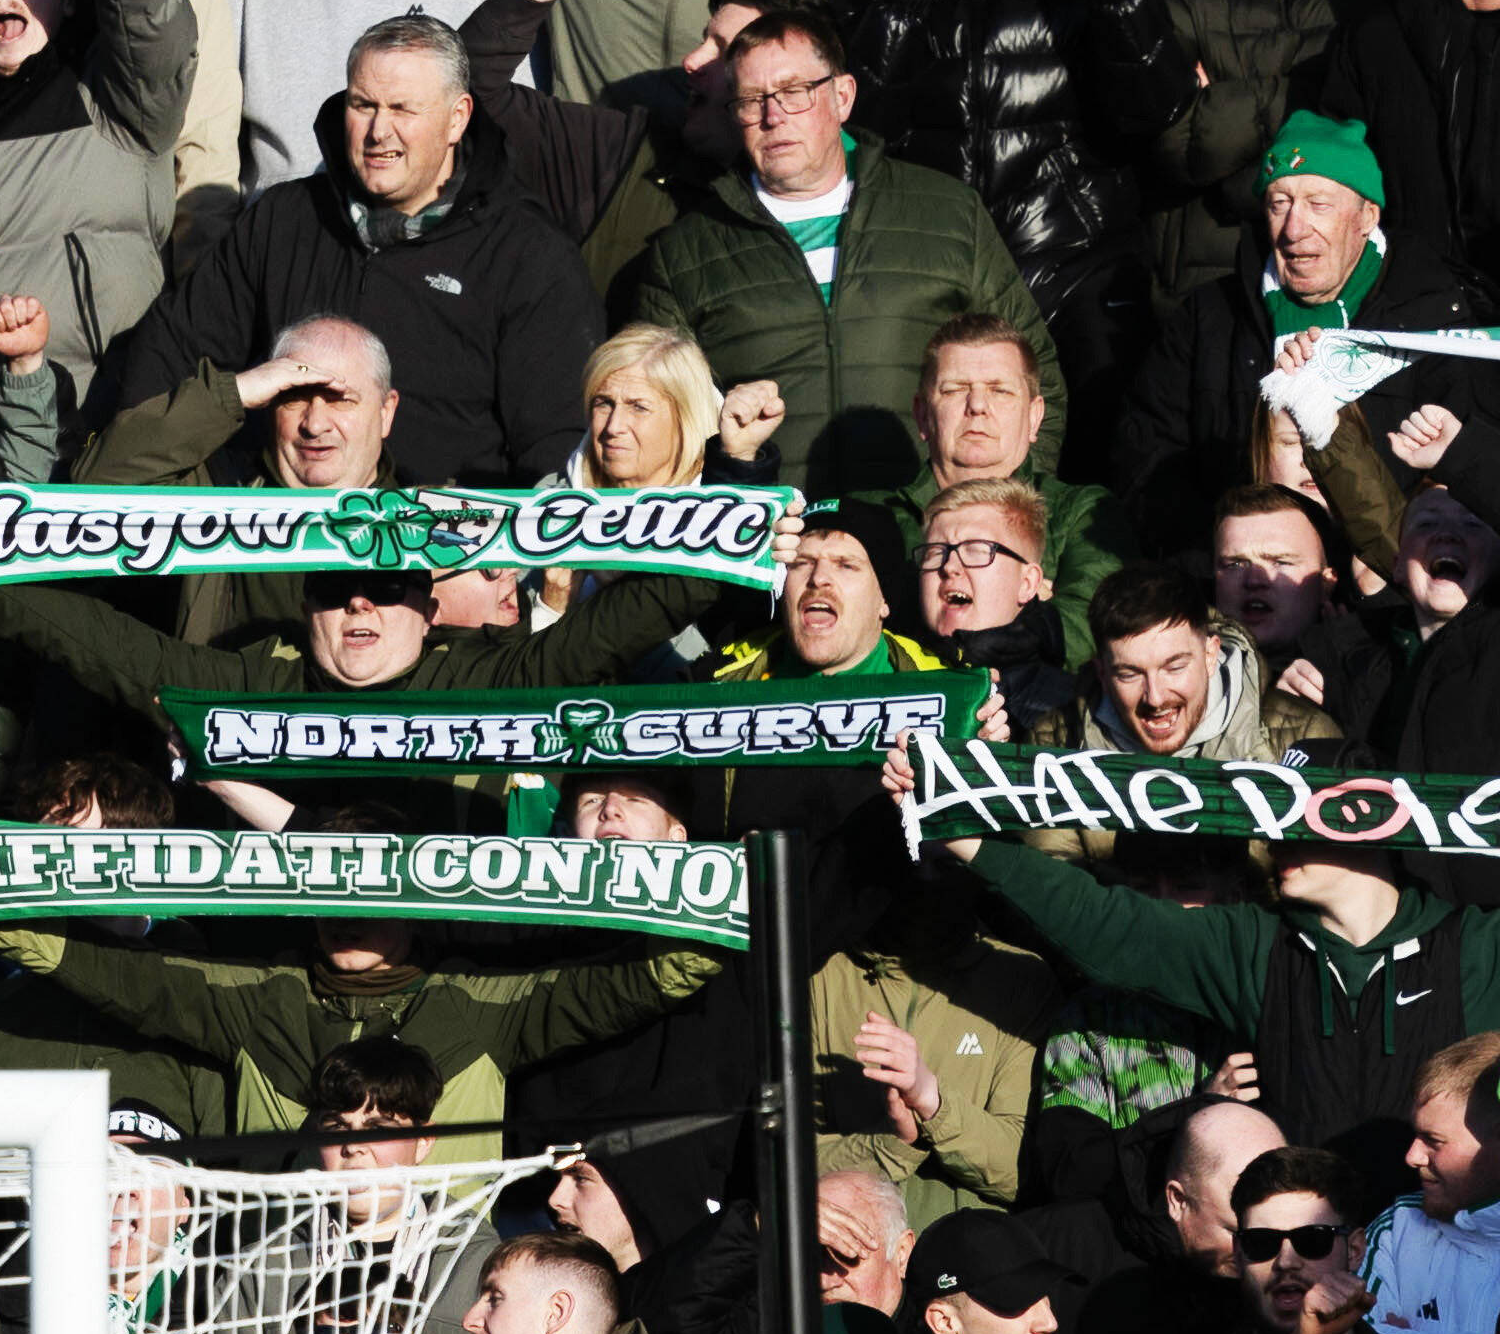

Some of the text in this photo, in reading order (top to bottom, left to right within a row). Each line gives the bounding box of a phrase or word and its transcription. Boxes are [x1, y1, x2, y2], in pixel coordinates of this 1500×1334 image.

[205, 694, 945, 765] NORTH CURVE
[409, 835, 603, 905] CON
[605, 838, 751, 920] NO
